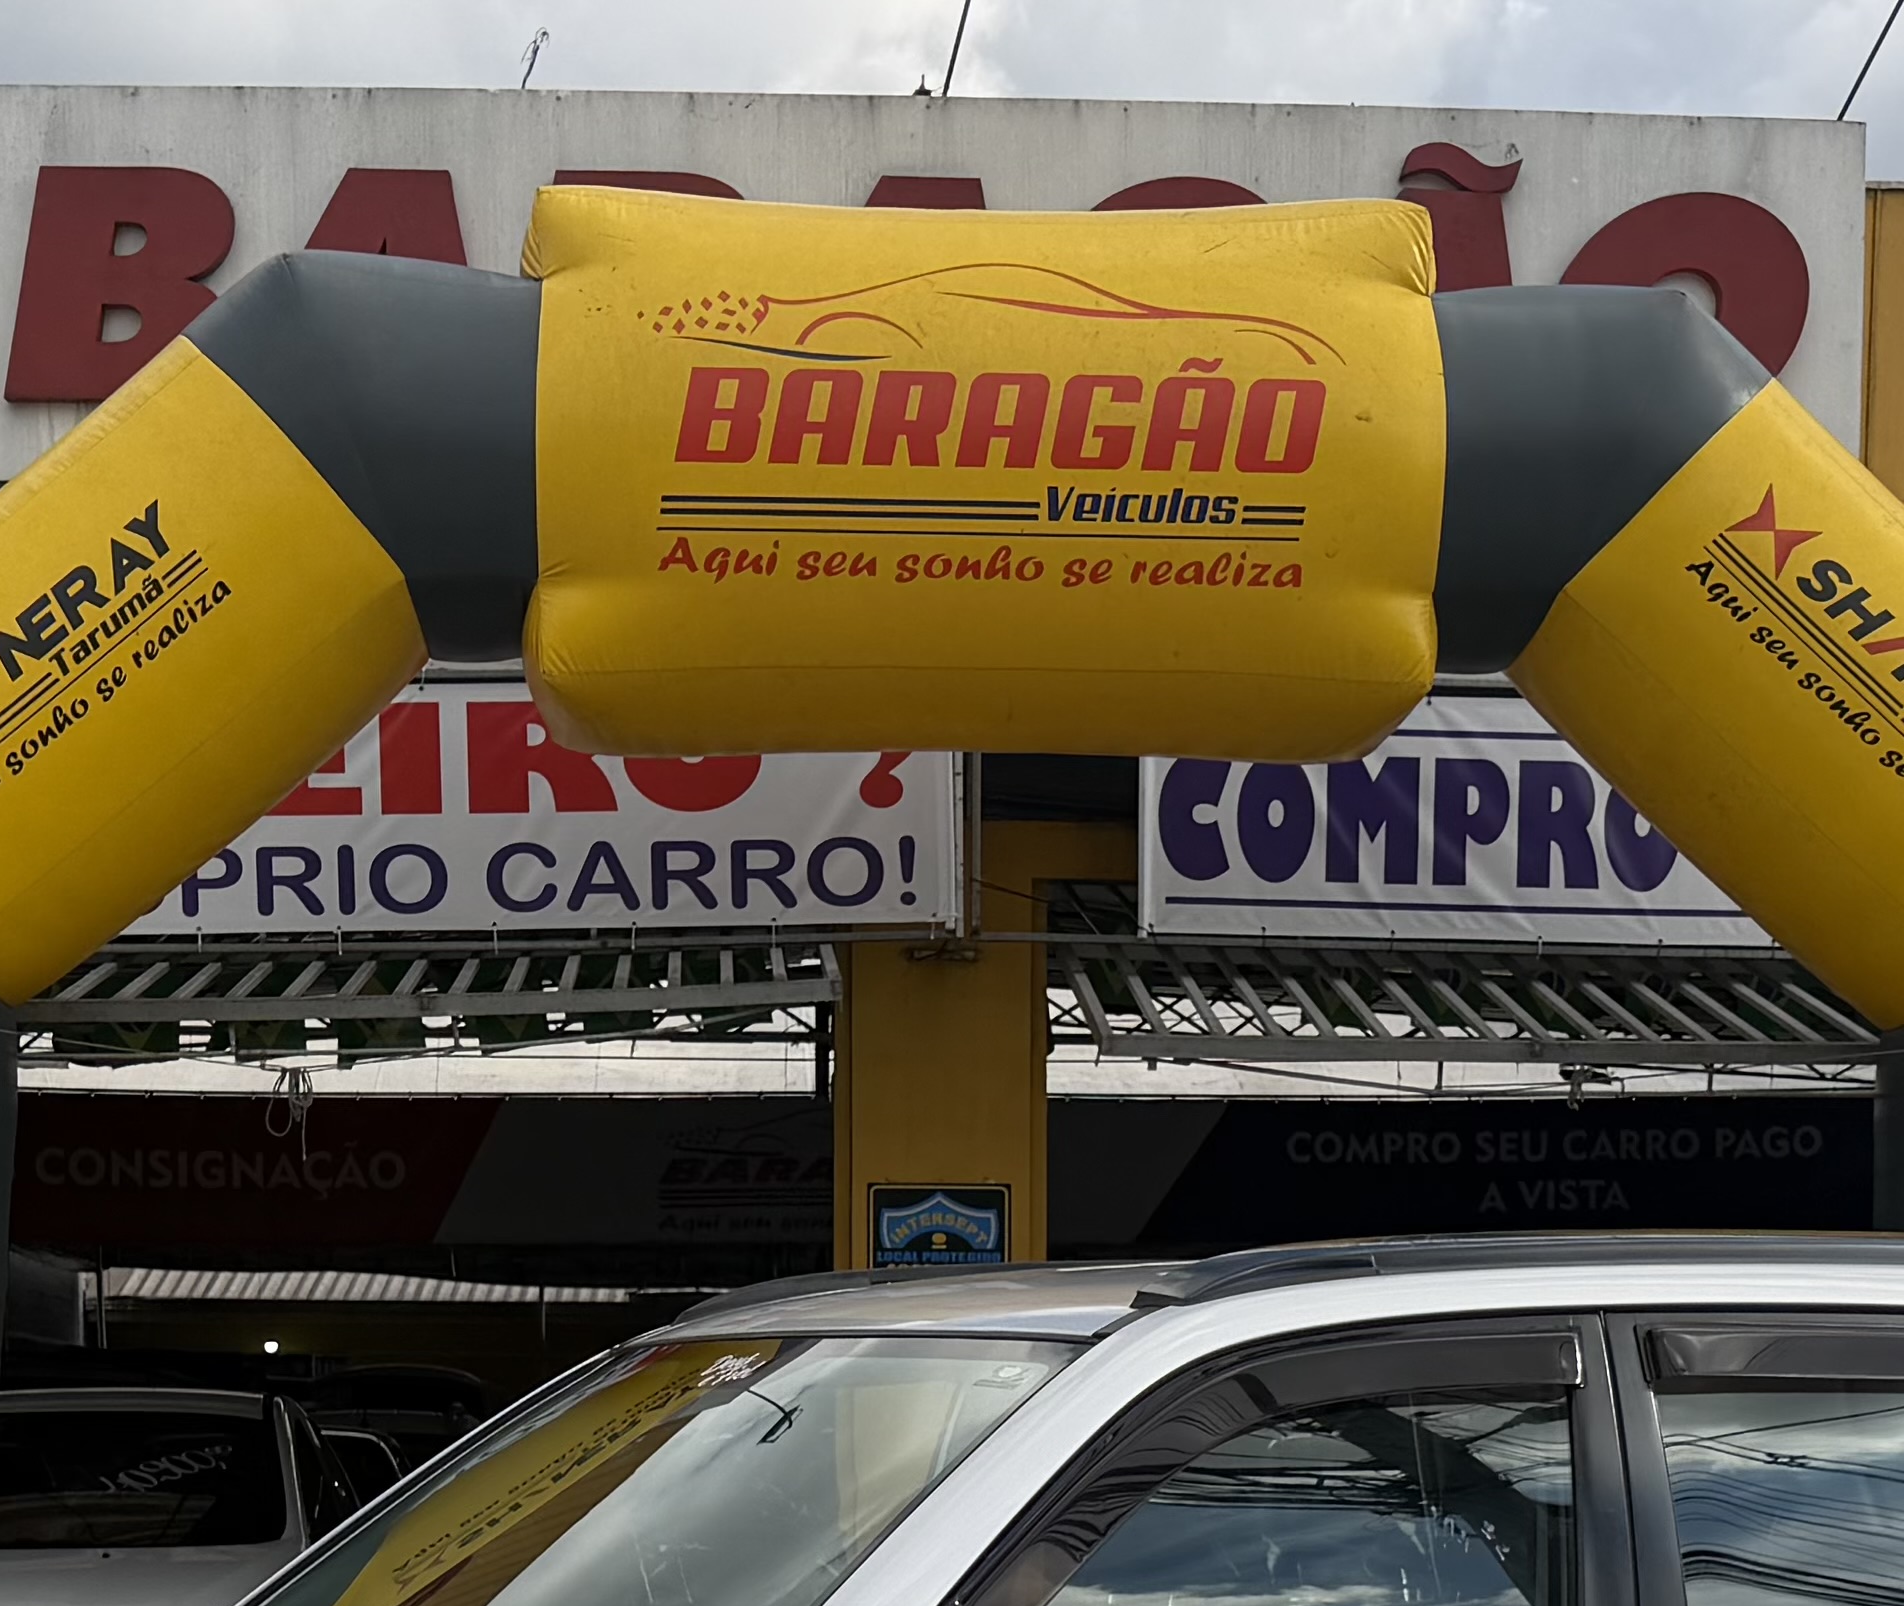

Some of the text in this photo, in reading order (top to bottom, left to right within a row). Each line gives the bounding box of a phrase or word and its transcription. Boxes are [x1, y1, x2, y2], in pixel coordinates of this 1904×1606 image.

[674, 356, 1328, 475] BARAGÃO
[1045, 485, 1240, 525] Veículos
[657, 536, 1304, 588] Aqui seu sonho se realiza
[48, 573, 166, 678] Tarumã
[1685, 559, 1759, 623] Aqui
[1749, 624, 1801, 671] seu
[1797, 670, 1882, 747] sonho
[5, 697, 90, 776] sonho
[96, 665, 128, 703] se
[131, 580, 233, 670] realiza
[1158, 755, 1679, 893] COMPRO
[485, 835, 918, 914] CARRO!
[33, 1136, 408, 1199] CONSIGNAÇÃO
[1283, 1124, 1825, 1166] COMPRO SEU CARRO PAGO
[1476, 1178, 1632, 1215] A VISTA
